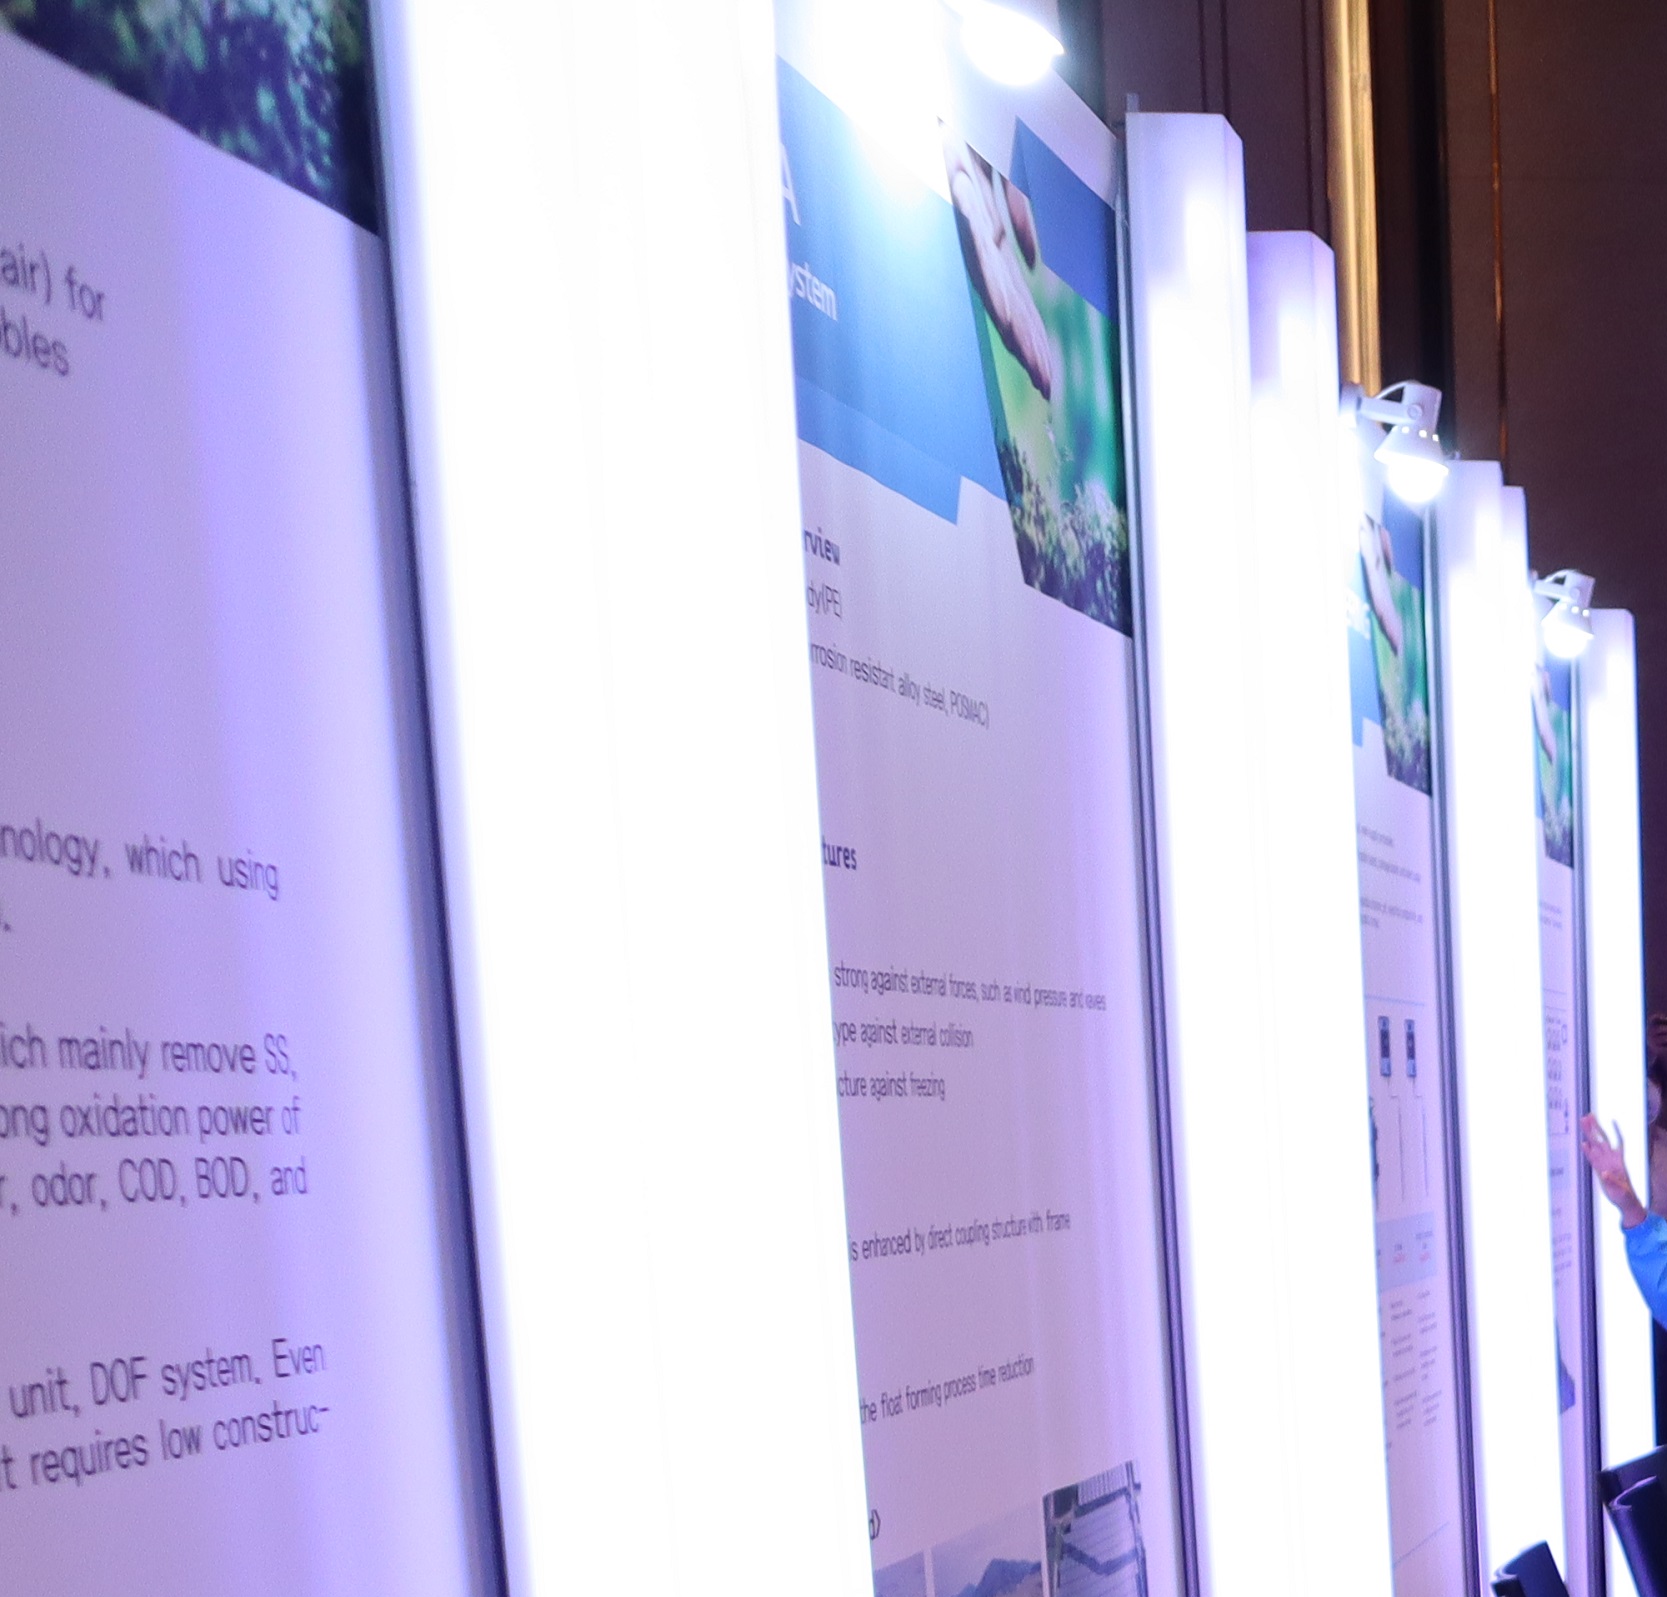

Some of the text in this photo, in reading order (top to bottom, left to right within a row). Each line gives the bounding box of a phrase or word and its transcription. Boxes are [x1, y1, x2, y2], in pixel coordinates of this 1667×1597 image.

[65, 264, 105, 321] for
[125, 834, 201, 884] which
[218, 848, 280, 901] using
[834, 960, 869, 995] strong
[870, 965, 909, 996] against
[910, 969, 947, 998] external
[981, 978, 1001, 1004] such
[58, 1026, 150, 1080] mainly
[160, 1039, 257, 1075] remove
[264, 1032, 299, 1081] SS,
[861, 1016, 898, 1049] against
[901, 1019, 938, 1047] external
[939, 1022, 974, 1049] collision
[870, 1070, 908, 1102] against
[910, 1070, 946, 1101] freezing
[59, 1092, 302, 1146] oxidation power of
[31, 1159, 109, 1210] odor,
[118, 1156, 189, 1209] COD,
[195, 1155, 261, 1204] BOD,
[269, 1156, 309, 1197] and
[862, 1227, 911, 1261] enhanced
[914, 1226, 927, 1257] by
[928, 1223, 954, 1251] direct
[955, 1218, 991, 1248] coupling
[9, 1336, 328, 1419] unit, DOF system. Even
[860, 1353, 1036, 1425] the float forming process time reduction
[30, 1399, 330, 1488] requires low construc-
